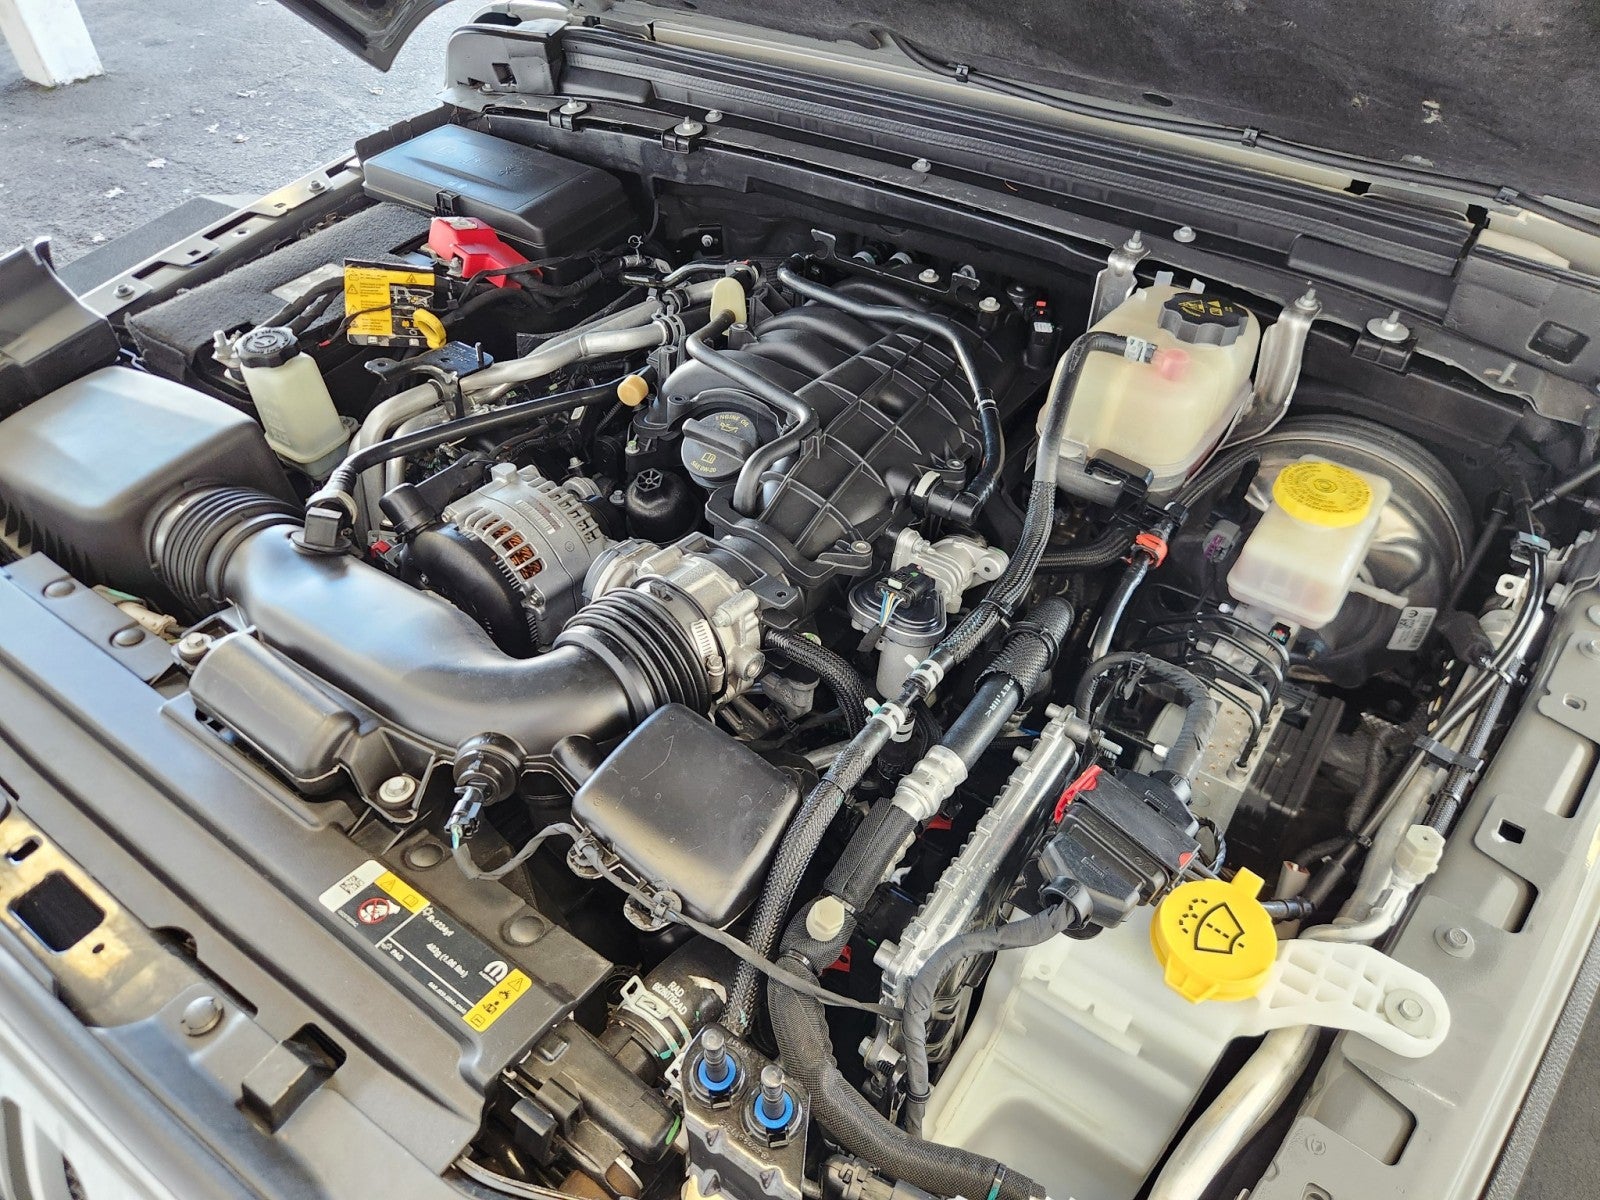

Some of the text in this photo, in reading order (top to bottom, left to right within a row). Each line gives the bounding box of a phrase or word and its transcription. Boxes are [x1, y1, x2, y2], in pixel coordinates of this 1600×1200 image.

[741, 419, 749, 428] OIL
[426, 915, 454, 937] R-1234yf
[390, 949, 404, 962] PAG
[668, 981, 685, 997] RAD
